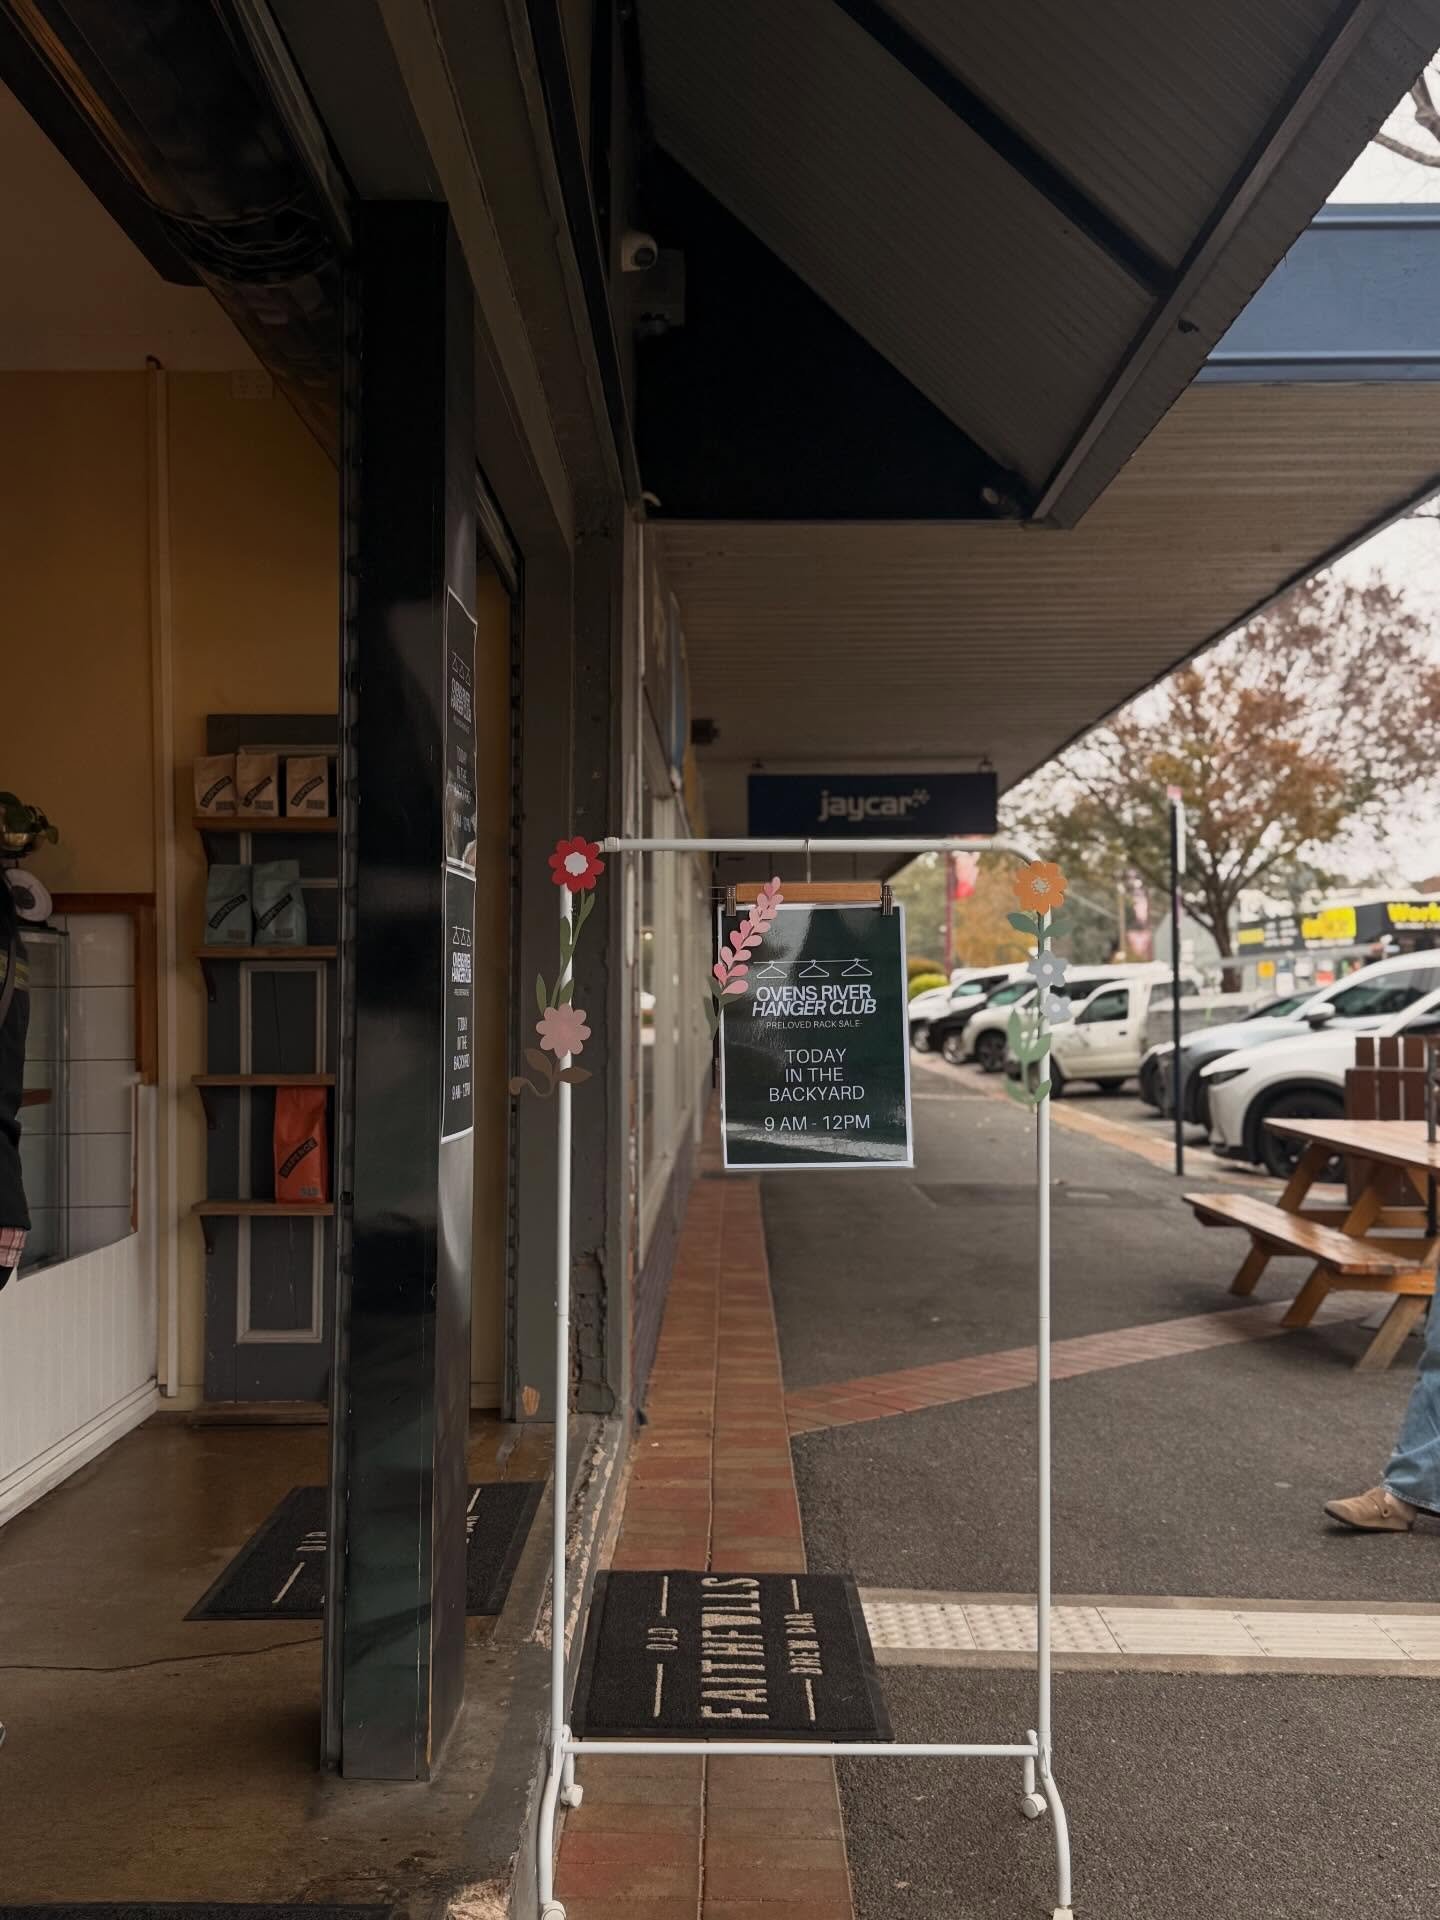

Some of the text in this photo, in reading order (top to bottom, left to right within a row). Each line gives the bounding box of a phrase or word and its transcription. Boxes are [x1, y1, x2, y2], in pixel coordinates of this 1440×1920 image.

[817, 788, 913, 822] jaycar
[756, 984, 871, 1002] OVENS RIVER
[752, 998, 877, 1017] HANGER CLUB
[766, 1020, 812, 1029] PRELOVED
[813, 1020, 837, 1028] RACK
[784, 1048, 847, 1064] TODAY
[785, 1066, 844, 1083] IN THE
[769, 1085, 865, 1102] BACKYARD
[764, 1116, 775, 1132] 9
[780, 1116, 807, 1130] AM
[822, 1114, 871, 1130] 12PM
[646, 1627, 679, 1651] OLD
[783, 1612, 824, 1675] BREW BAR
